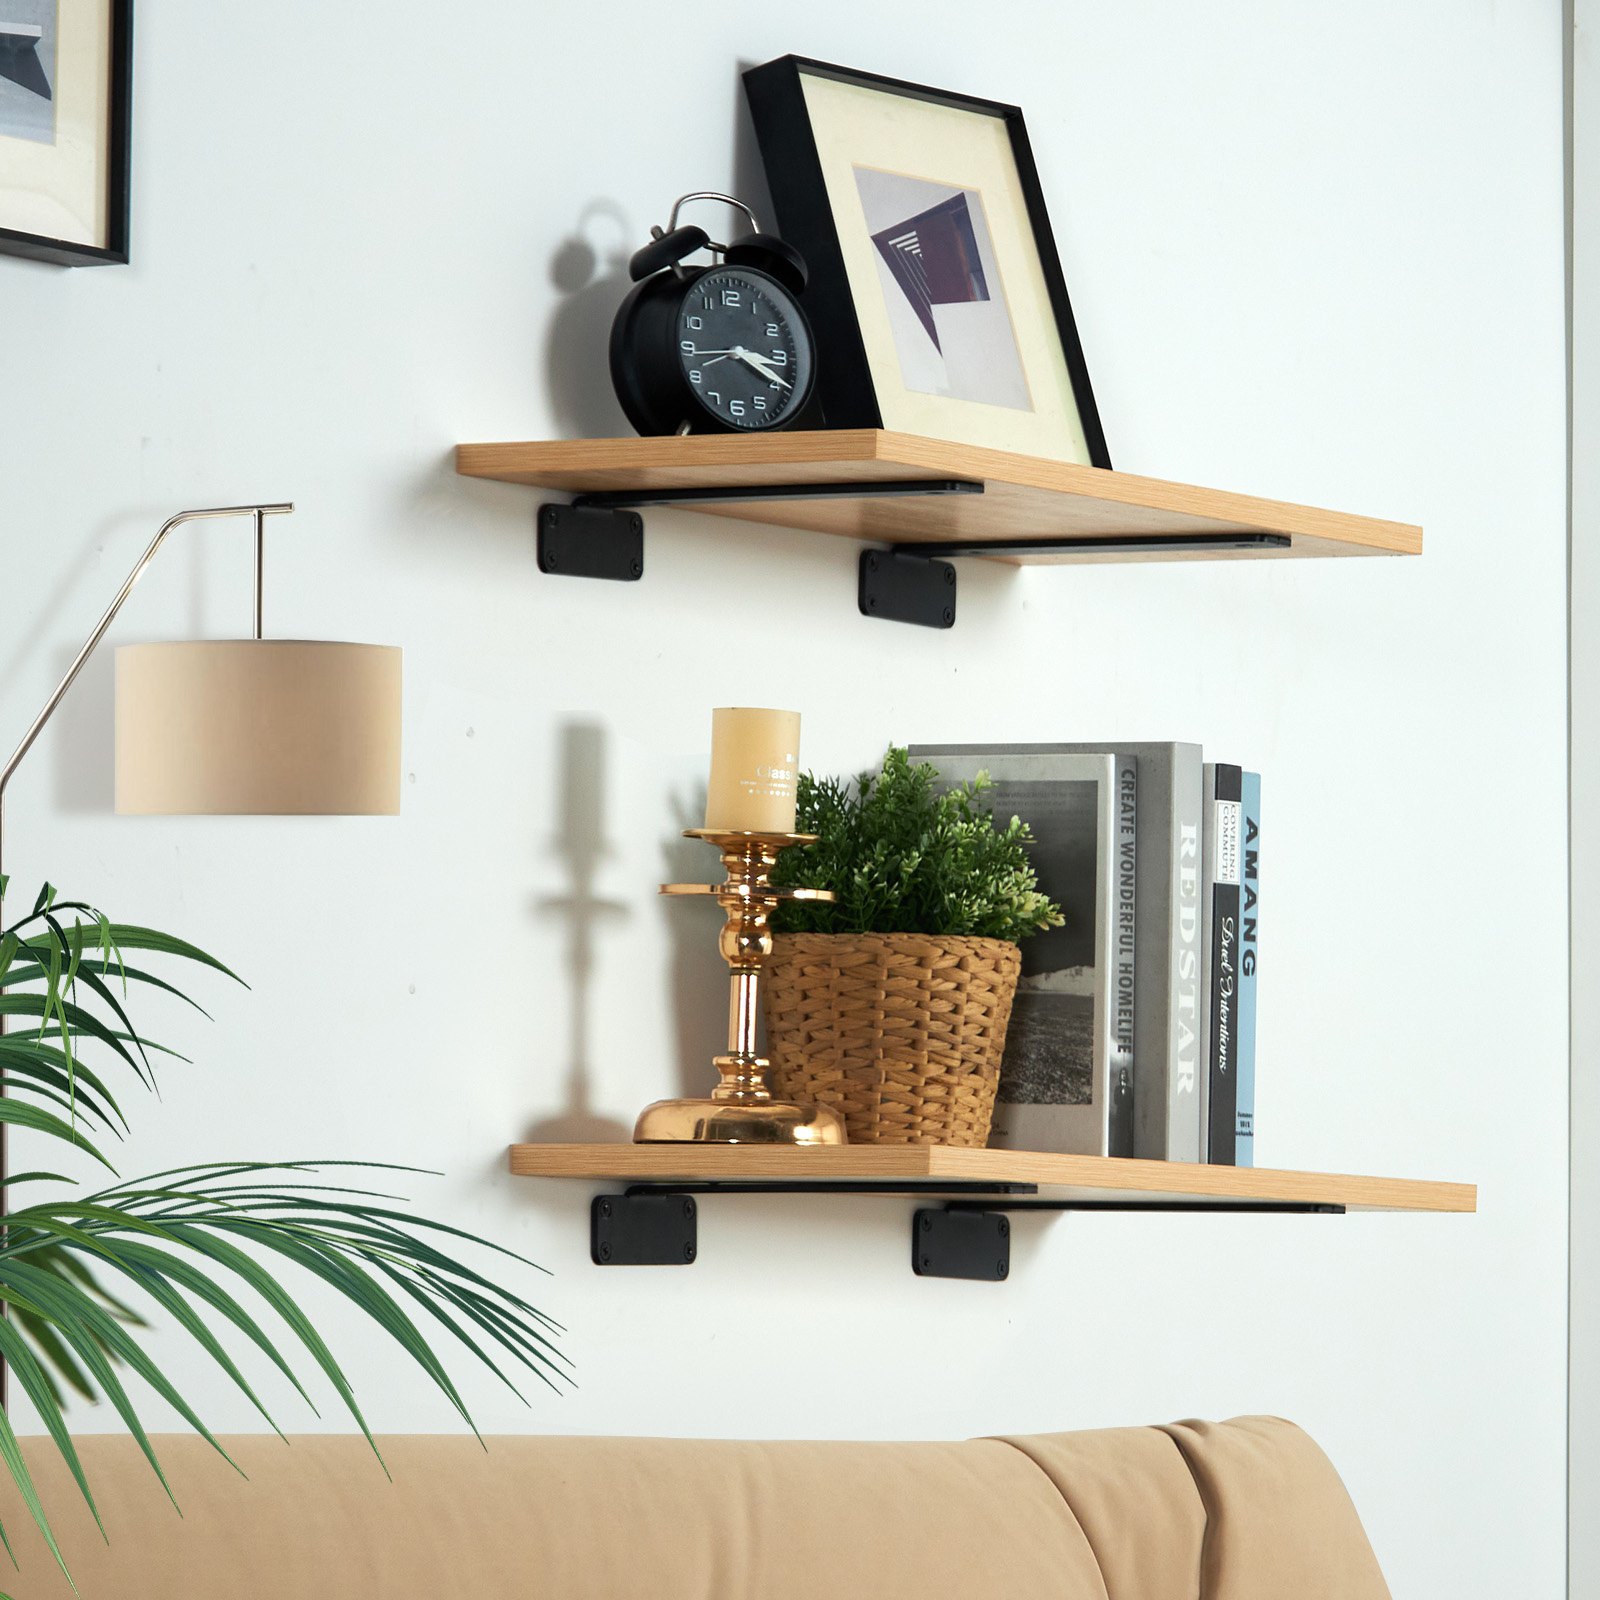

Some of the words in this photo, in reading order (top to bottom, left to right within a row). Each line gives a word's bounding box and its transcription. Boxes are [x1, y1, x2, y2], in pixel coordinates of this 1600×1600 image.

[704, 297, 713, 310] 11
[721, 290, 741, 307] 12
[686, 316, 702, 330] 10
[766, 323, 779, 337] 2
[680, 341, 695, 357] 9
[772, 350, 787, 366] 3
[689, 370, 702, 384] 8
[707, 391, 721, 405] 7
[753, 396, 766, 410] 5
[729, 400, 745, 416] 6
[1120, 768, 1136, 834] CREATE
[1221, 805, 1229, 880] COMMUTE
[1229, 803, 1237, 880] COVERING
[1118, 840, 1135, 956] WONDERFUL
[1242, 816, 1259, 977] AMANG
[1219, 916, 1235, 974] Duel
[1177, 822, 1197, 1096] REDSTAR
[1117, 962, 1133, 1054] HOMELIFE
[1218, 975, 1234, 1075] Intentions
